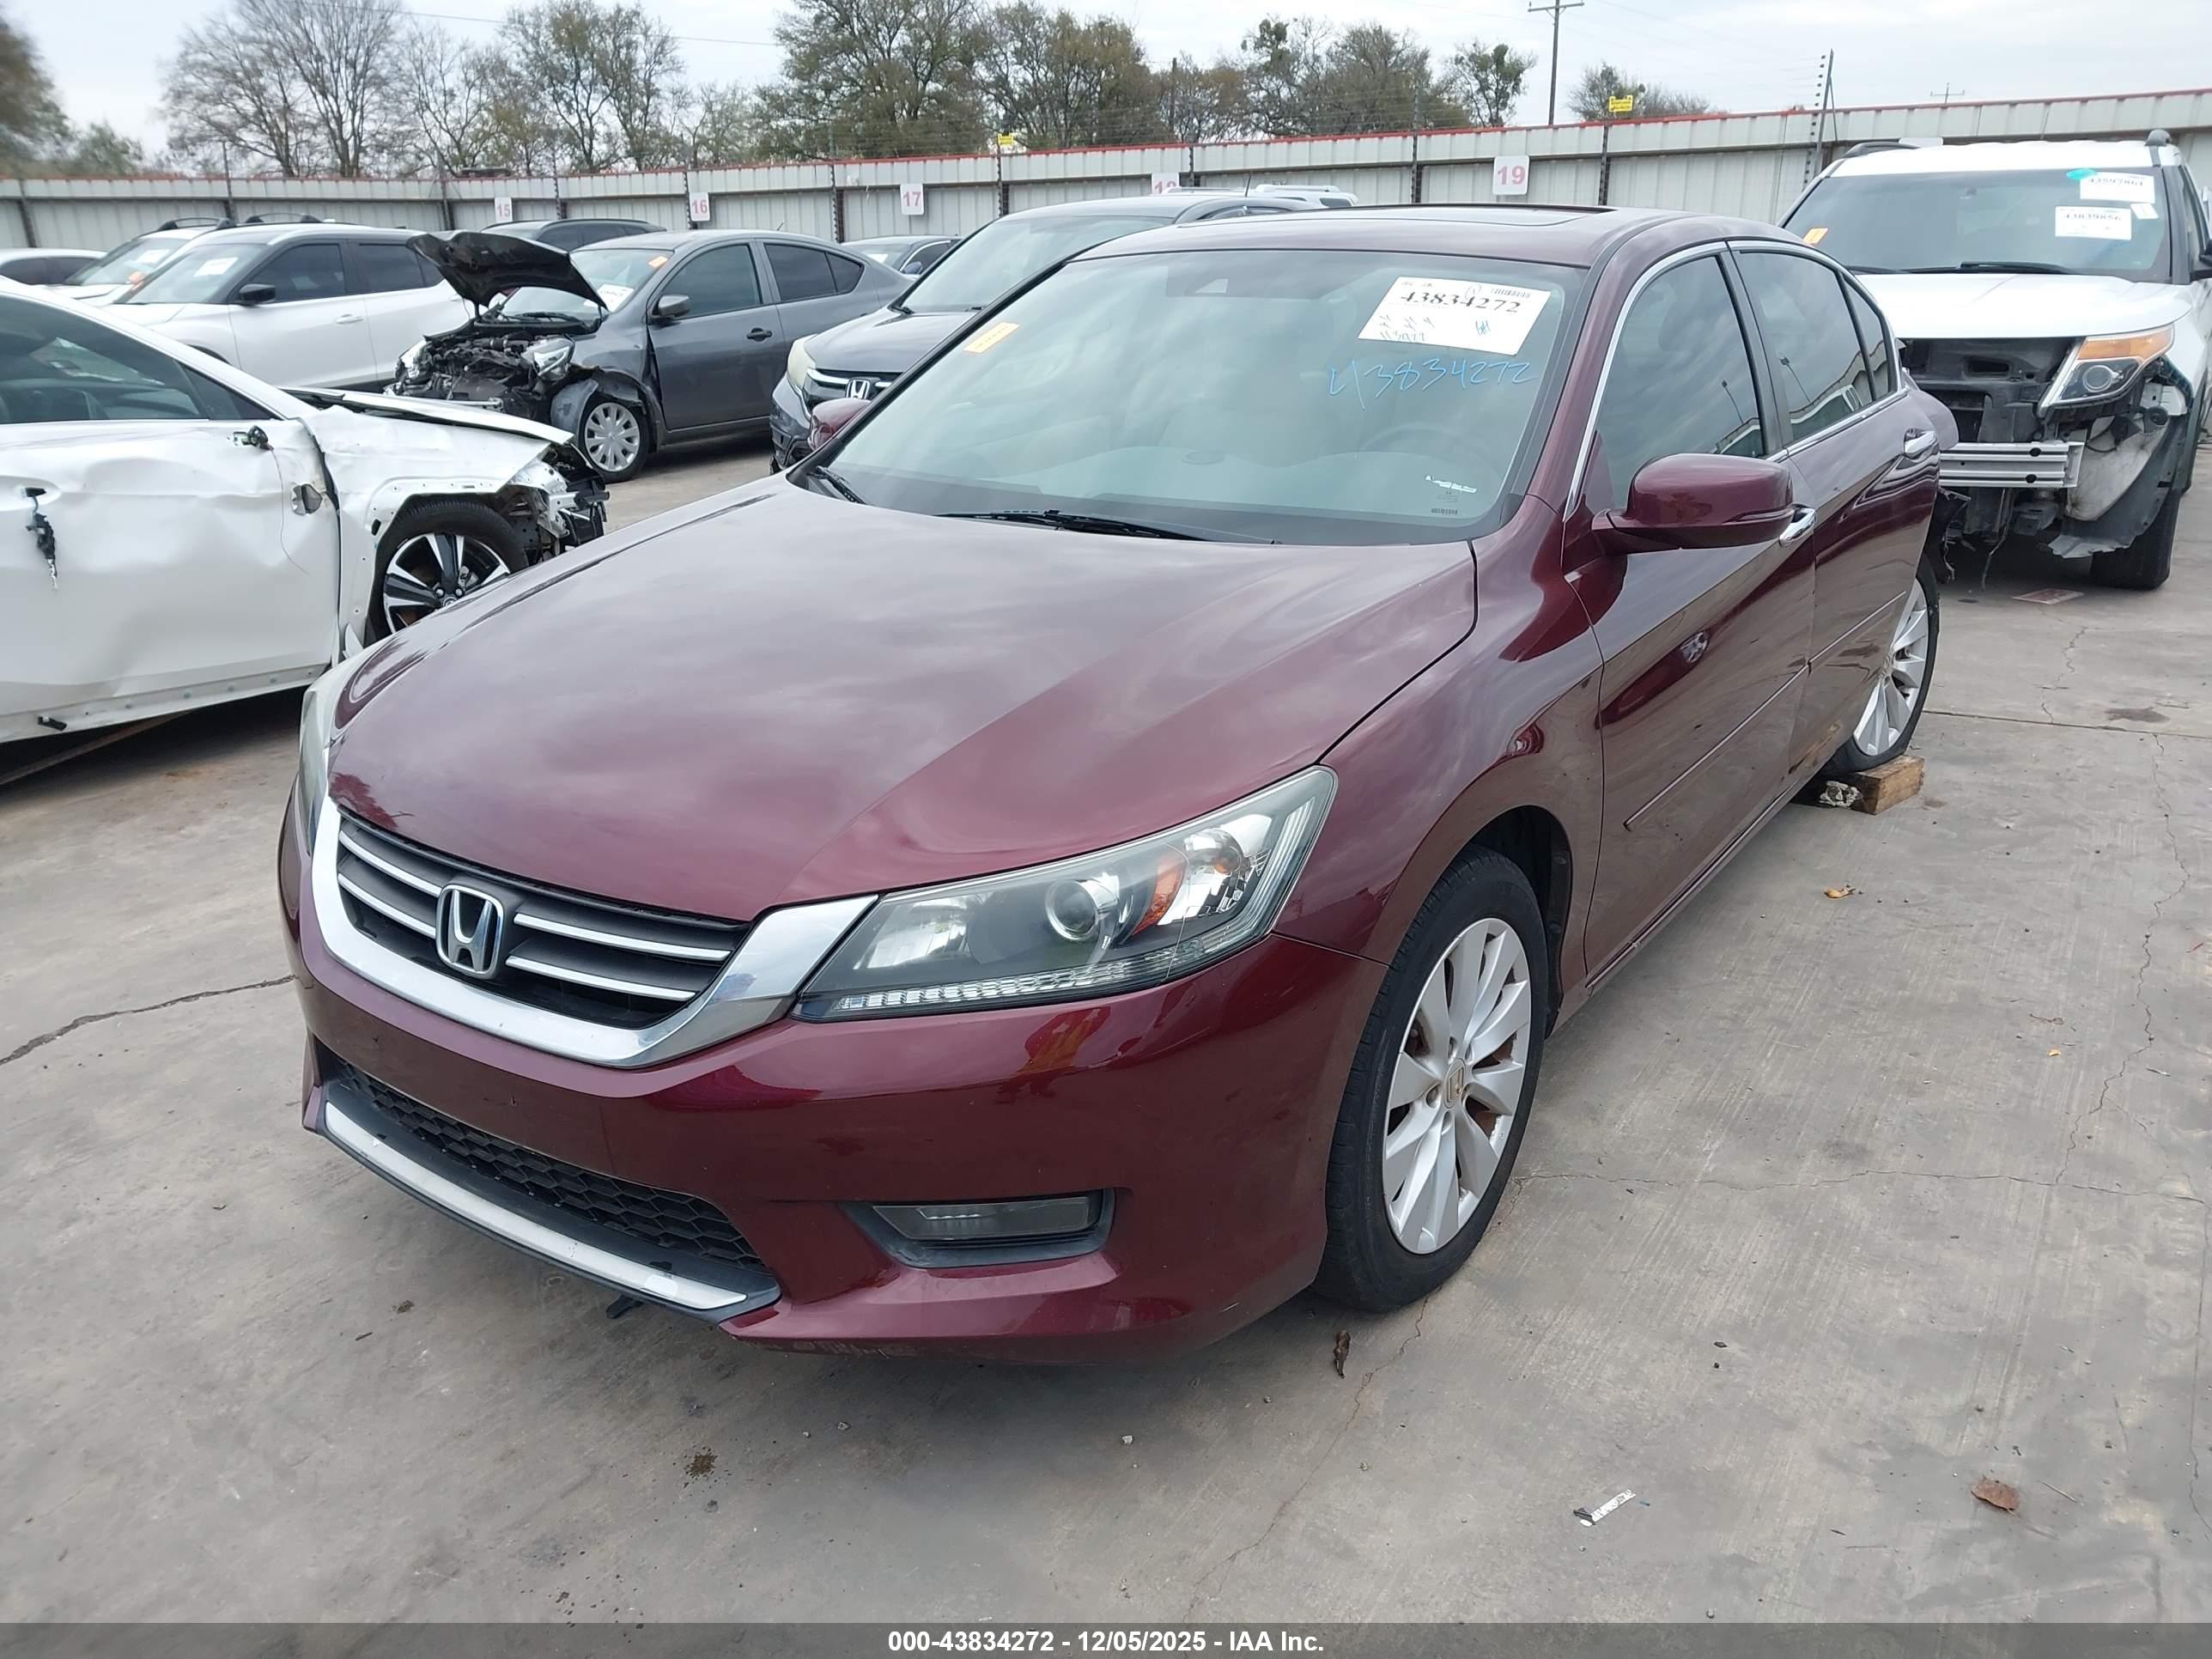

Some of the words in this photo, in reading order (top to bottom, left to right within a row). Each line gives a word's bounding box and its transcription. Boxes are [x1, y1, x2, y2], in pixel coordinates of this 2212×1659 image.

[1497, 165, 1526, 185] 19
[691, 199, 708, 214] 16
[902, 191, 921, 207] 17
[497, 204, 510, 216] 15
[1401, 291, 1521, 313] 43834272
[1329, 357, 1539, 410] 43834272
